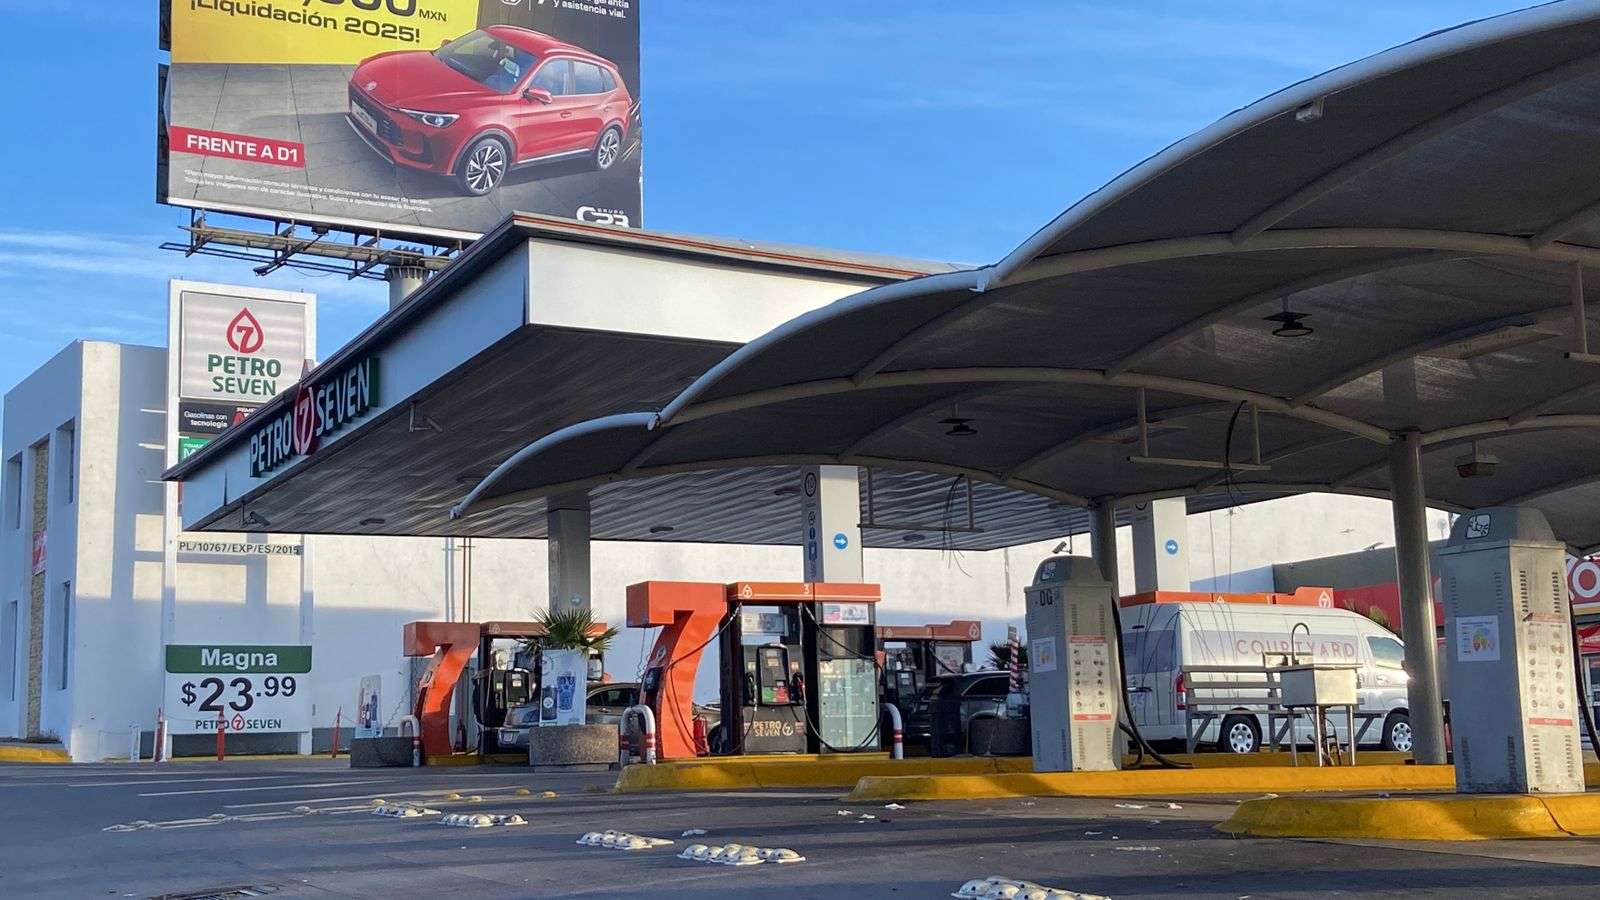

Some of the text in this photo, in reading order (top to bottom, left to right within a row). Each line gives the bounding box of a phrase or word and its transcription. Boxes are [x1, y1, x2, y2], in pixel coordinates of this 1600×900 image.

[419, 9, 447, 22] MXN
[561, 2, 607, 15] asistencia
[609, 9, 626, 18] vial.
[344, 17, 420, 43] 2025!
[187, 134, 297, 162] FRENTE A D1
[208, 354, 281, 377] PETRO
[212, 376, 276, 396] SEVEN
[250, 411, 292, 478] PETRO
[316, 357, 370, 437] SEVEN
[1236, 639, 1354, 657] COURTYARD
[201, 648, 278, 670] Magna
[246, 719, 282, 729] SEVEN
[753, 721, 782, 730] PETRO
[755, 729, 781, 737] SEVEN
